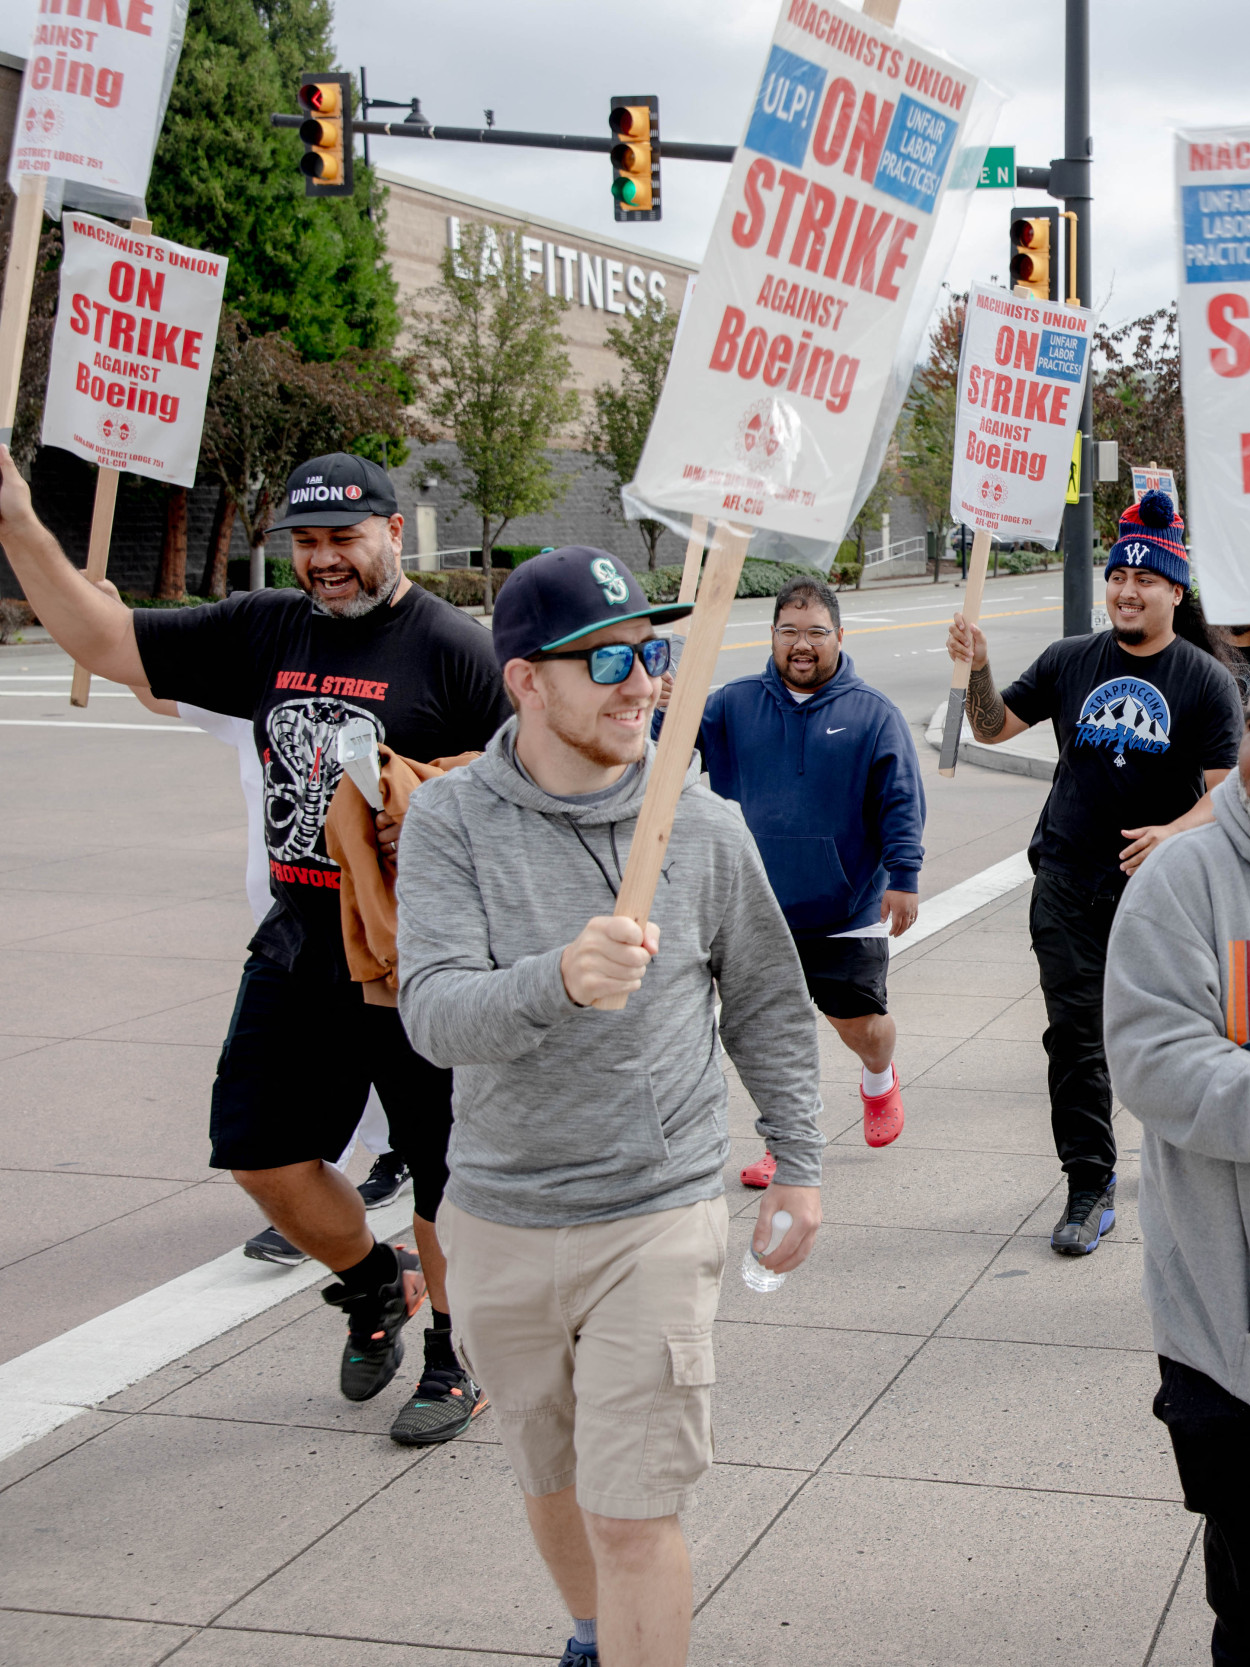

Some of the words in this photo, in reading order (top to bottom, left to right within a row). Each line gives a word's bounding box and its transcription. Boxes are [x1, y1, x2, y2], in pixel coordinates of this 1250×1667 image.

[787, 0, 903, 80] MACHINISTS
[904, 57, 967, 112] UNION
[762, 73, 815, 129] ULP!
[813, 76, 895, 185] ON
[906, 104, 946, 144] UNFAIR
[17, 159, 51, 171] AFL-CIO
[53, 149, 84, 165] LODGE
[87, 157, 103, 170] 751
[900, 131, 937, 167] LABOR
[880, 152, 940, 197] PRACTICES!
[997, 166, 1009, 184] N
[731, 157, 919, 303] STRIKE
[72, 221, 165, 262] MACHINISTS
[168, 252, 220, 278] UNION
[108, 260, 166, 313] ON
[446, 216, 506, 288] LA
[518, 235, 667, 325] FITNESS
[756, 273, 849, 332] AGAINST
[976, 293, 1040, 323] MACHINISTS
[1042, 311, 1087, 333] UNION
[70, 293, 204, 371] STRIKE
[1050, 333, 1079, 350] UNFAIR
[708, 304, 861, 414] Boeing
[994, 325, 1040, 373] ON
[1049, 346, 1075, 361] LABOR
[93, 351, 162, 383] AGAINST
[1038, 356, 1082, 376] PRACTICES!
[75, 361, 180, 424] Boeing
[967, 364, 1071, 427] STRIKE
[979, 416, 1032, 443] AGAINST
[95, 445, 127, 460] DISTRICT
[129, 453, 151, 465] LODGE
[152, 459, 164, 469] 751
[97, 455, 127, 469] AFL-CIO
[965, 430, 1047, 482] Boeing
[291, 486, 344, 504] UNION
[310, 475, 323, 484] AM
[1146, 477, 1160, 490] ON
[722, 493, 765, 516] AFL-CIO
[799, 489, 816, 507] 751
[974, 508, 1000, 521] DISTRICT
[1000, 512, 1021, 524] LODGE
[1021, 517, 1033, 526] 751
[975, 516, 999, 530] AFL-CIO
[1123, 542, 1151, 566] W
[275, 671, 318, 692] WILL
[320, 676, 389, 701] STRIKE
[1090, 683, 1164, 721] TRAPPUCCINO
[1074, 722, 1135, 755] TRAPPY
[1128, 734, 1171, 755] VALLEY
